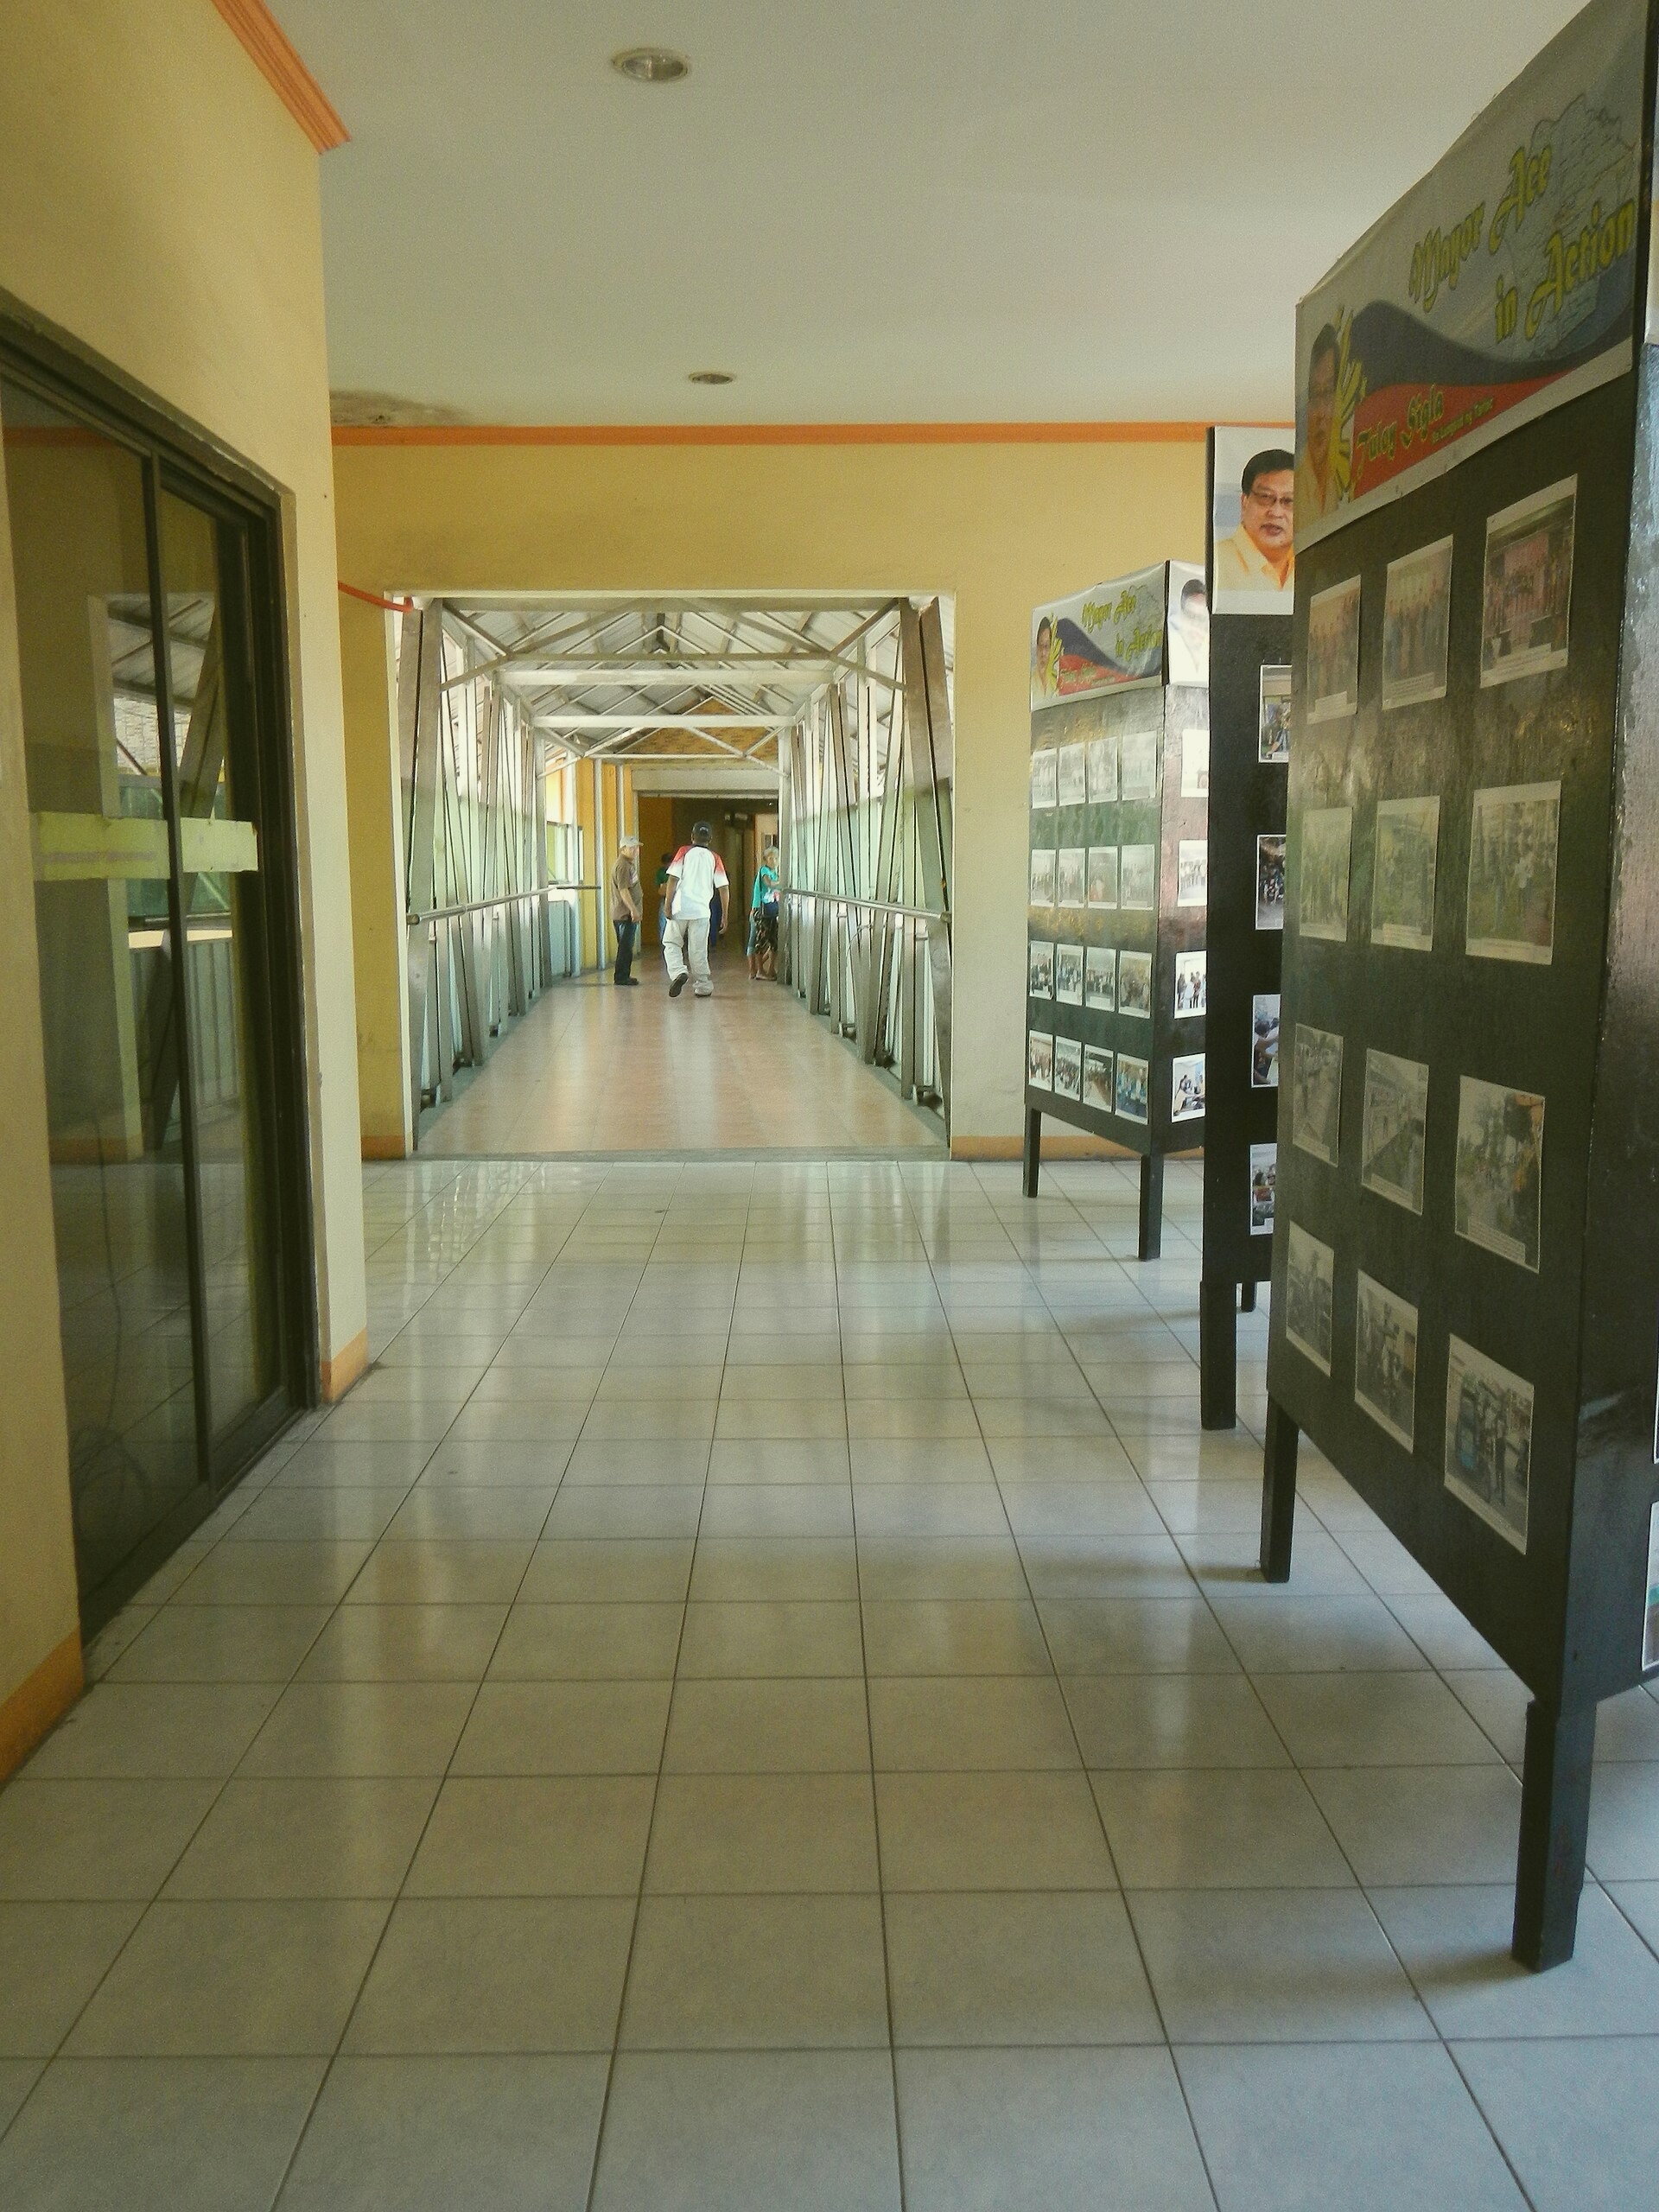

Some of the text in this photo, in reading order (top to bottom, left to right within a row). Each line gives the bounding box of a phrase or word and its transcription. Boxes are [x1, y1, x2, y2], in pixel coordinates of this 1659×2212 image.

[1408, 144, 1553, 313] Mayor Ace
[1495, 197, 1636, 345] in Action
